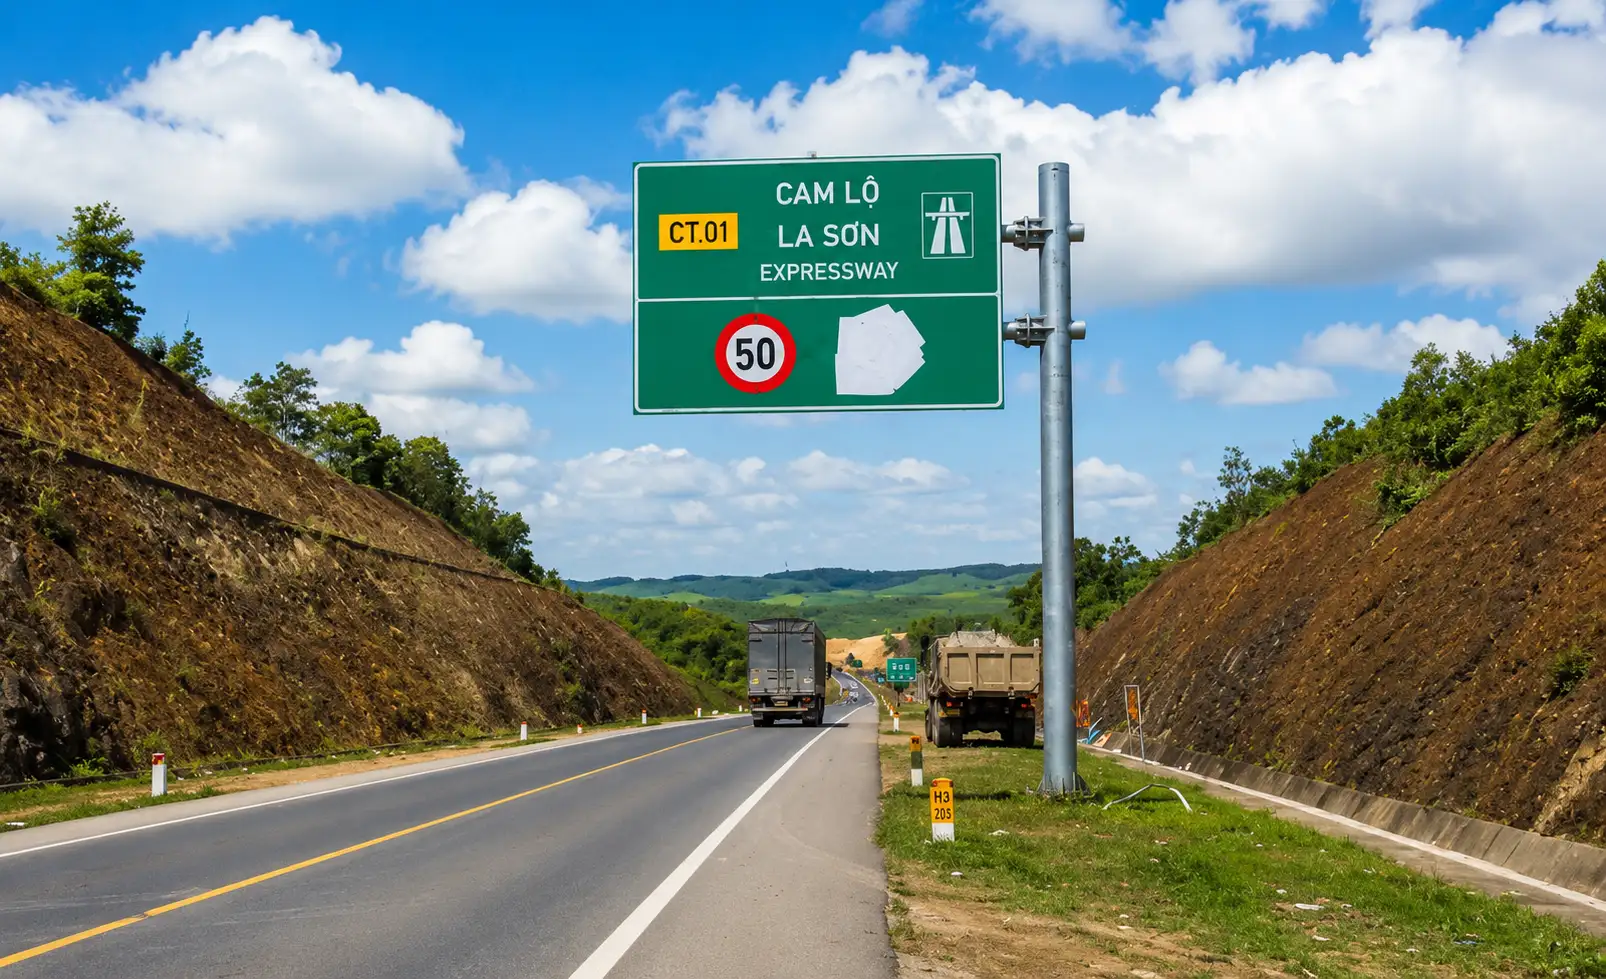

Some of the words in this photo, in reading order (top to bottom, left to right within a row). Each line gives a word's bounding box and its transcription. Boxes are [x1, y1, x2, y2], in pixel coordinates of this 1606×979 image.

[776, 181, 834, 205] CAM
[845, 175, 879, 209] LỘ
[669, 221, 728, 244] CT.01
[778, 224, 814, 248] LA
[823, 221, 879, 247] SƠN
[760, 261, 899, 281] EXPRESSWAY
[735, 337, 776, 371] 50
[934, 791, 950, 804] H3
